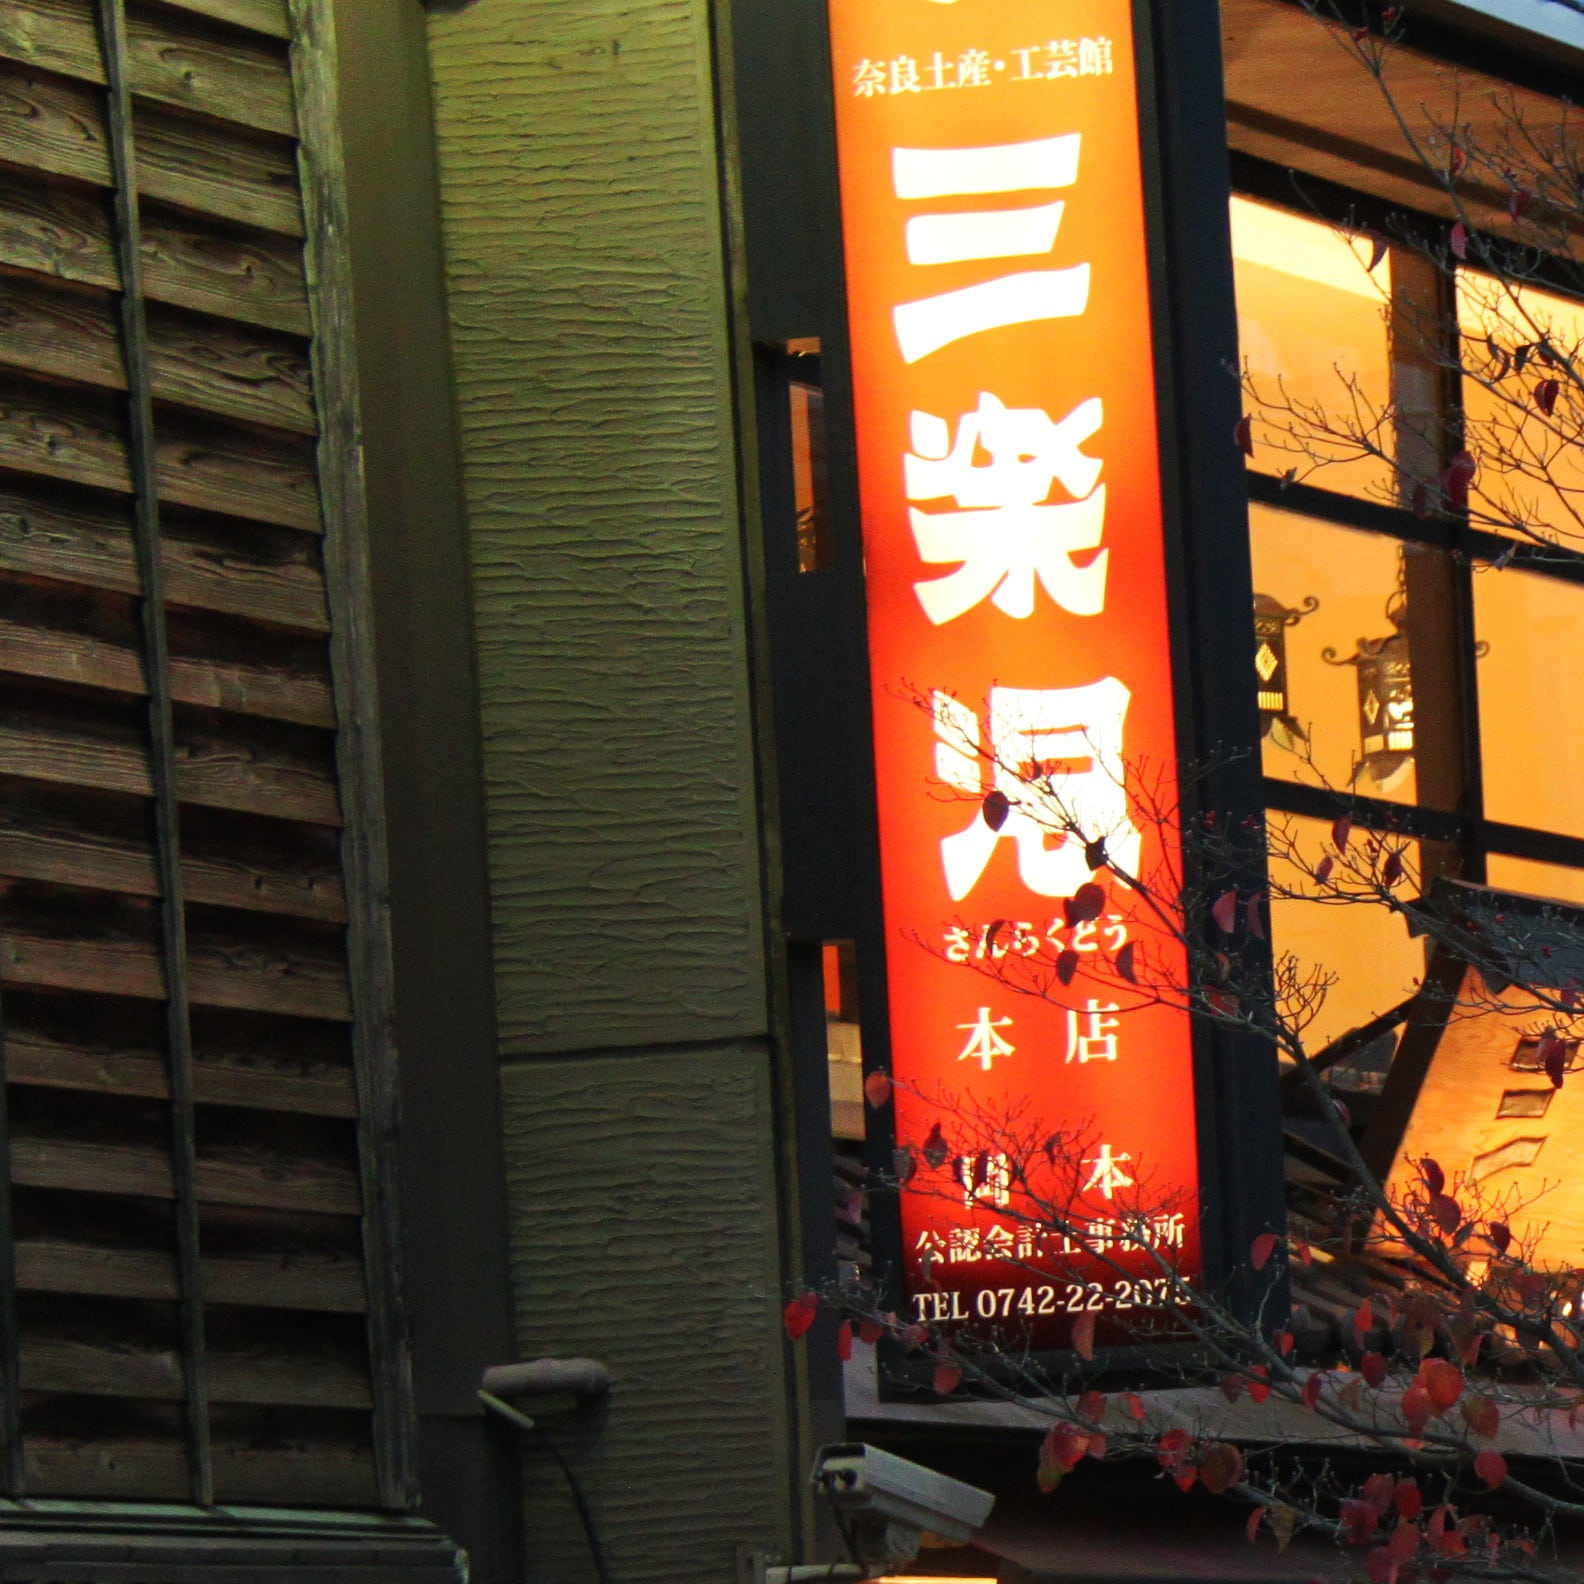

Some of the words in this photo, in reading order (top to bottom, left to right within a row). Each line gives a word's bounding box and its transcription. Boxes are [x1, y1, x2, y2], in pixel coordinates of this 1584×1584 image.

[853, 36, 1113, 98] 奈良土産・工芸館
[944, 914, 1128, 962] さんらくどう
[912, 1290, 970, 1322] TEL
